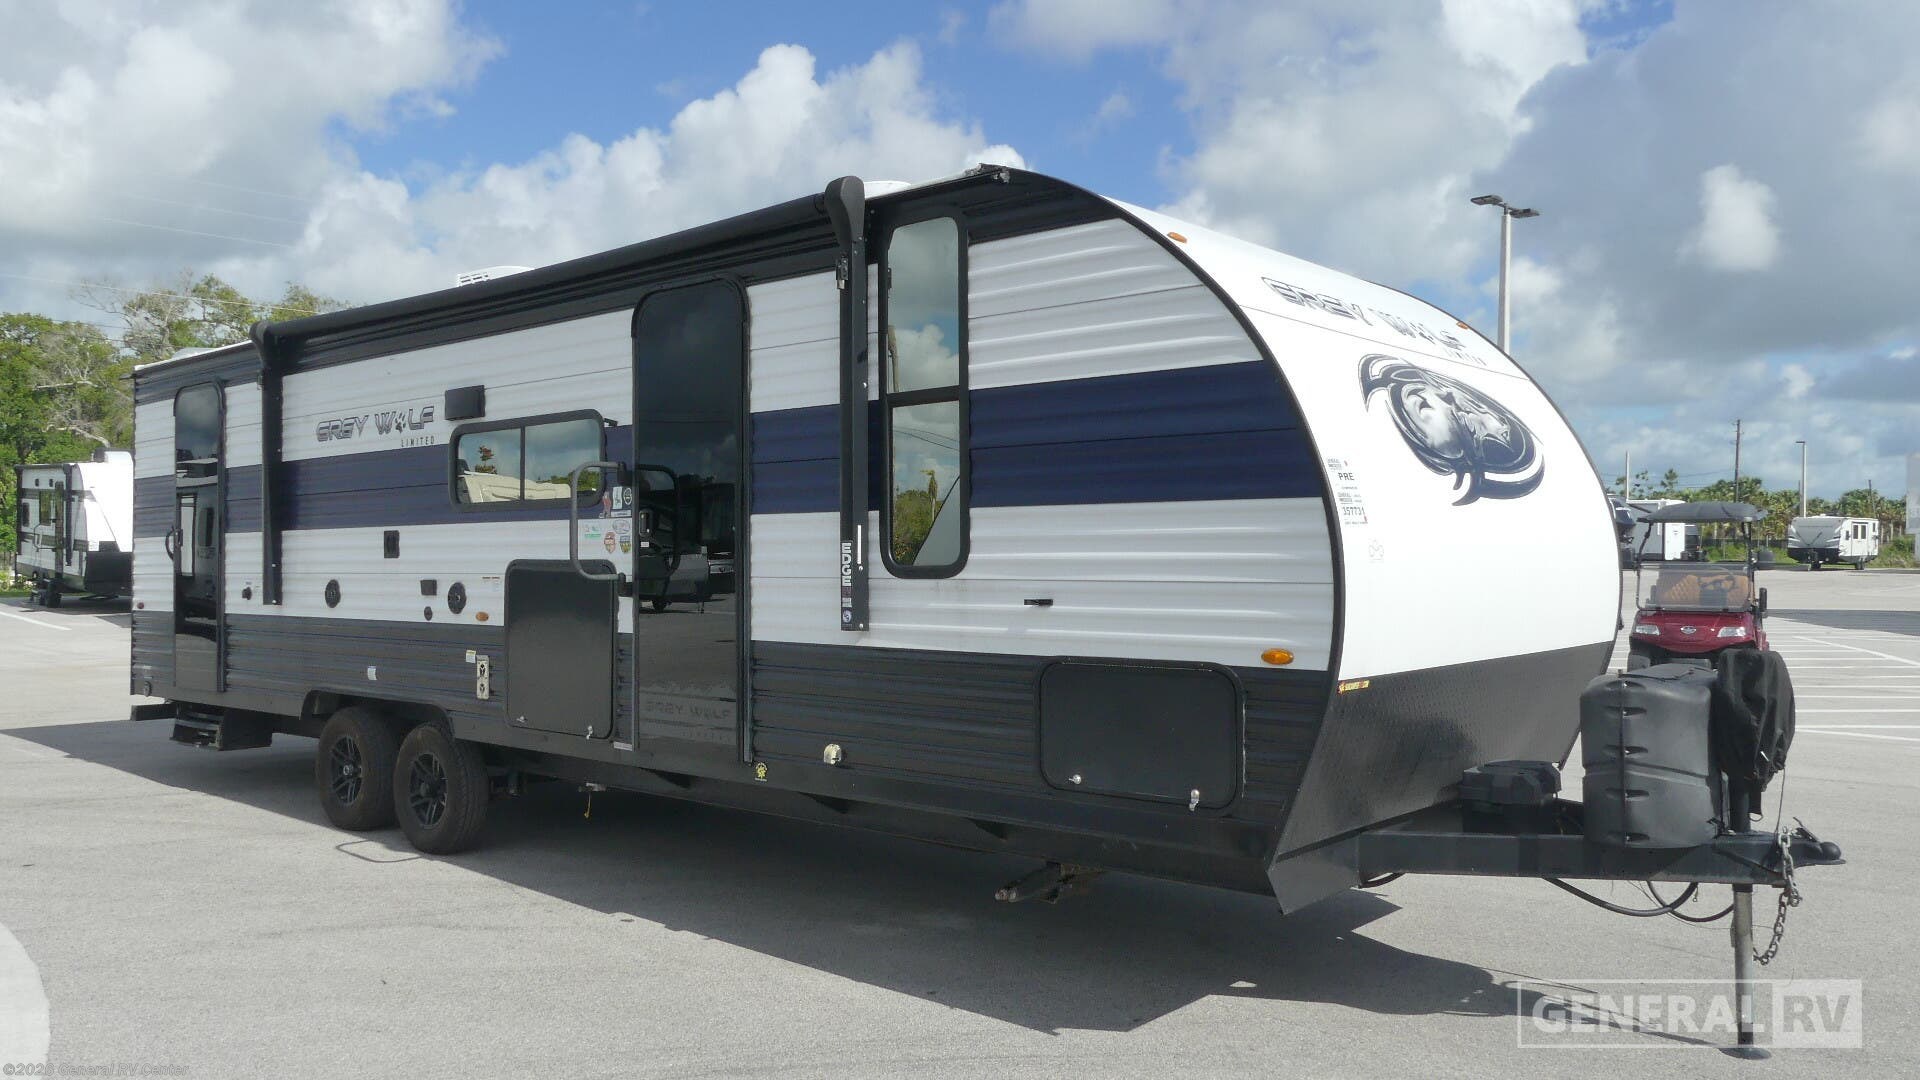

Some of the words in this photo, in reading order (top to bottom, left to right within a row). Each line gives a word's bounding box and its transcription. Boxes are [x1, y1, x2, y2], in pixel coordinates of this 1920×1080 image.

[1261, 276, 1374, 327] GREY
[316, 414, 370, 442] GREY
[401, 436, 435, 448] LIMITED
[1337, 472, 1355, 481] PRE
[841, 542, 852, 587] EDGE
